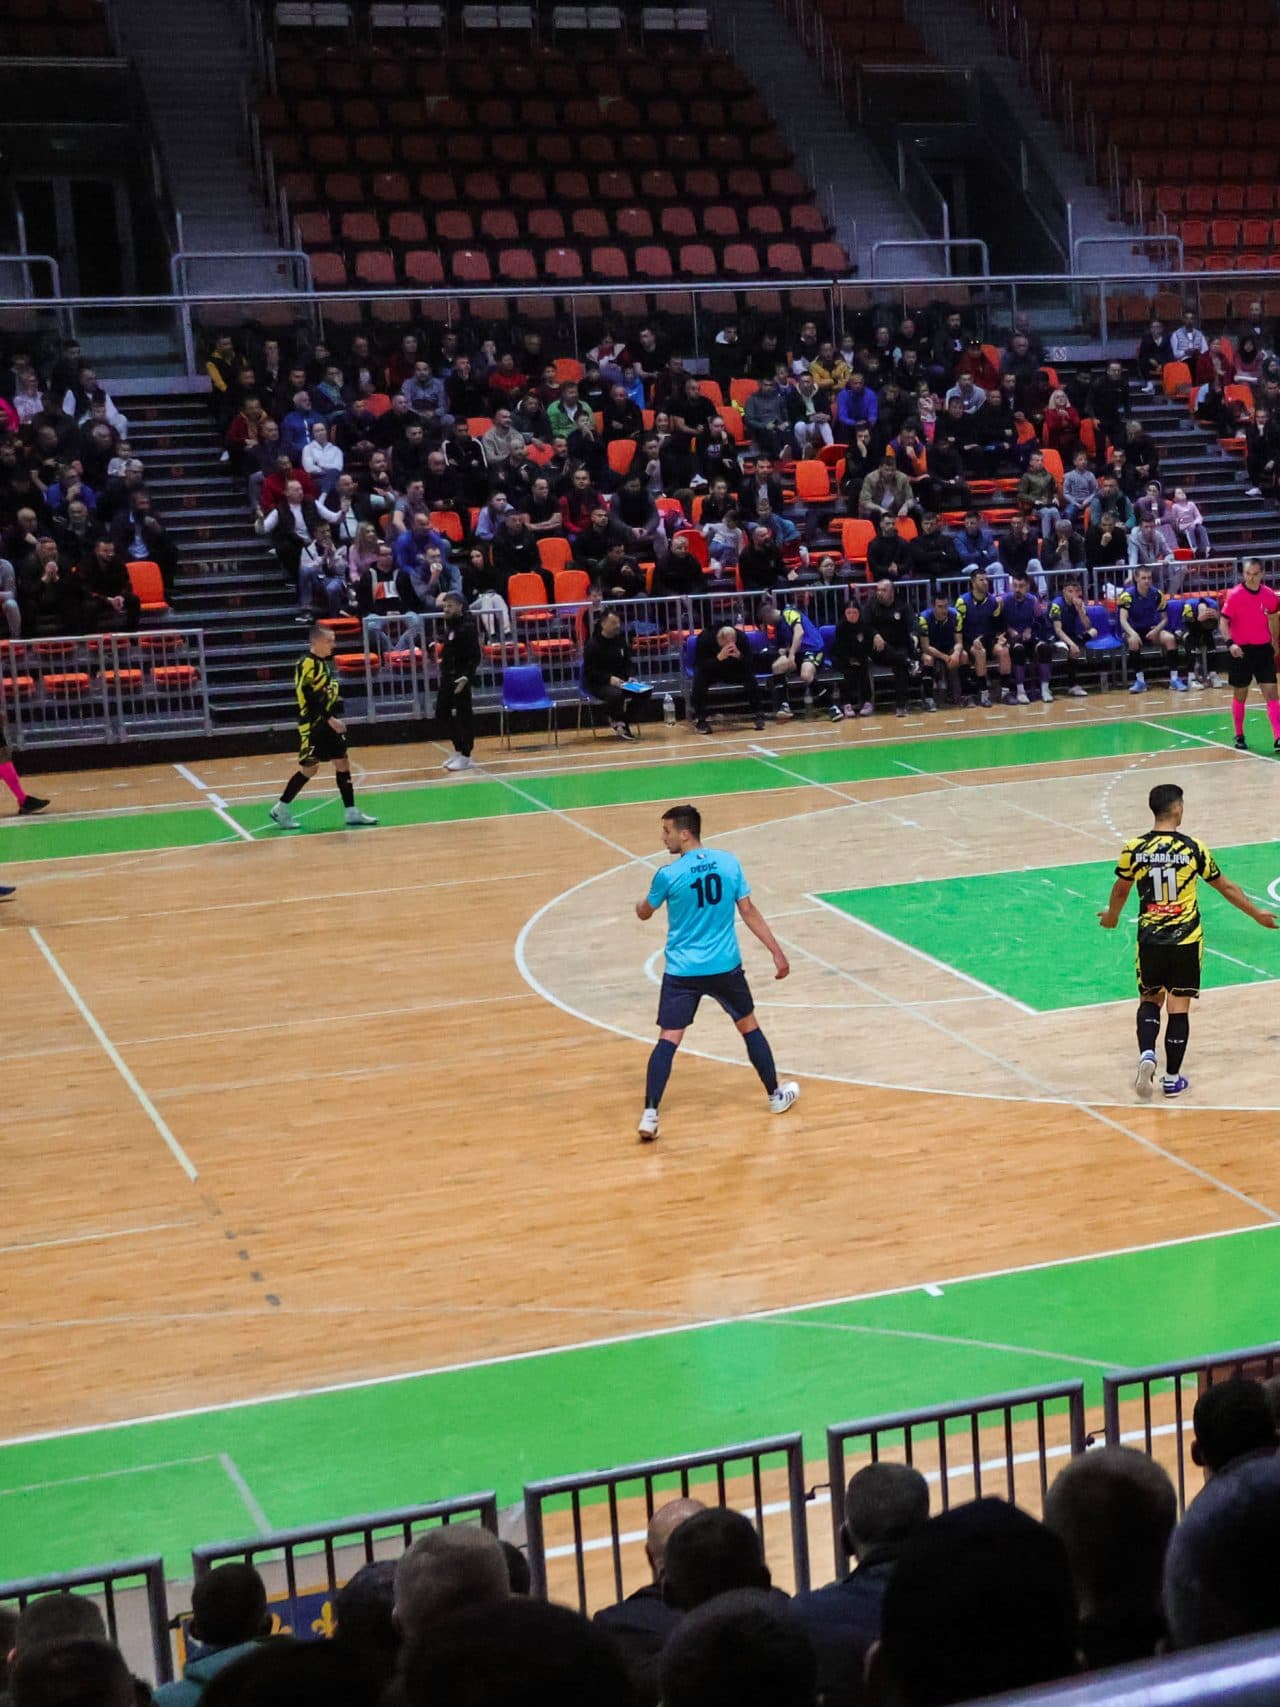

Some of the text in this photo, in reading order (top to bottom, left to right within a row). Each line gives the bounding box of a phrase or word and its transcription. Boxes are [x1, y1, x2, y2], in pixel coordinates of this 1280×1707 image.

[1150, 853, 1190, 864] SARAJEVO
[690, 873, 722, 908] 10
[1149, 867, 1177, 901] 11
